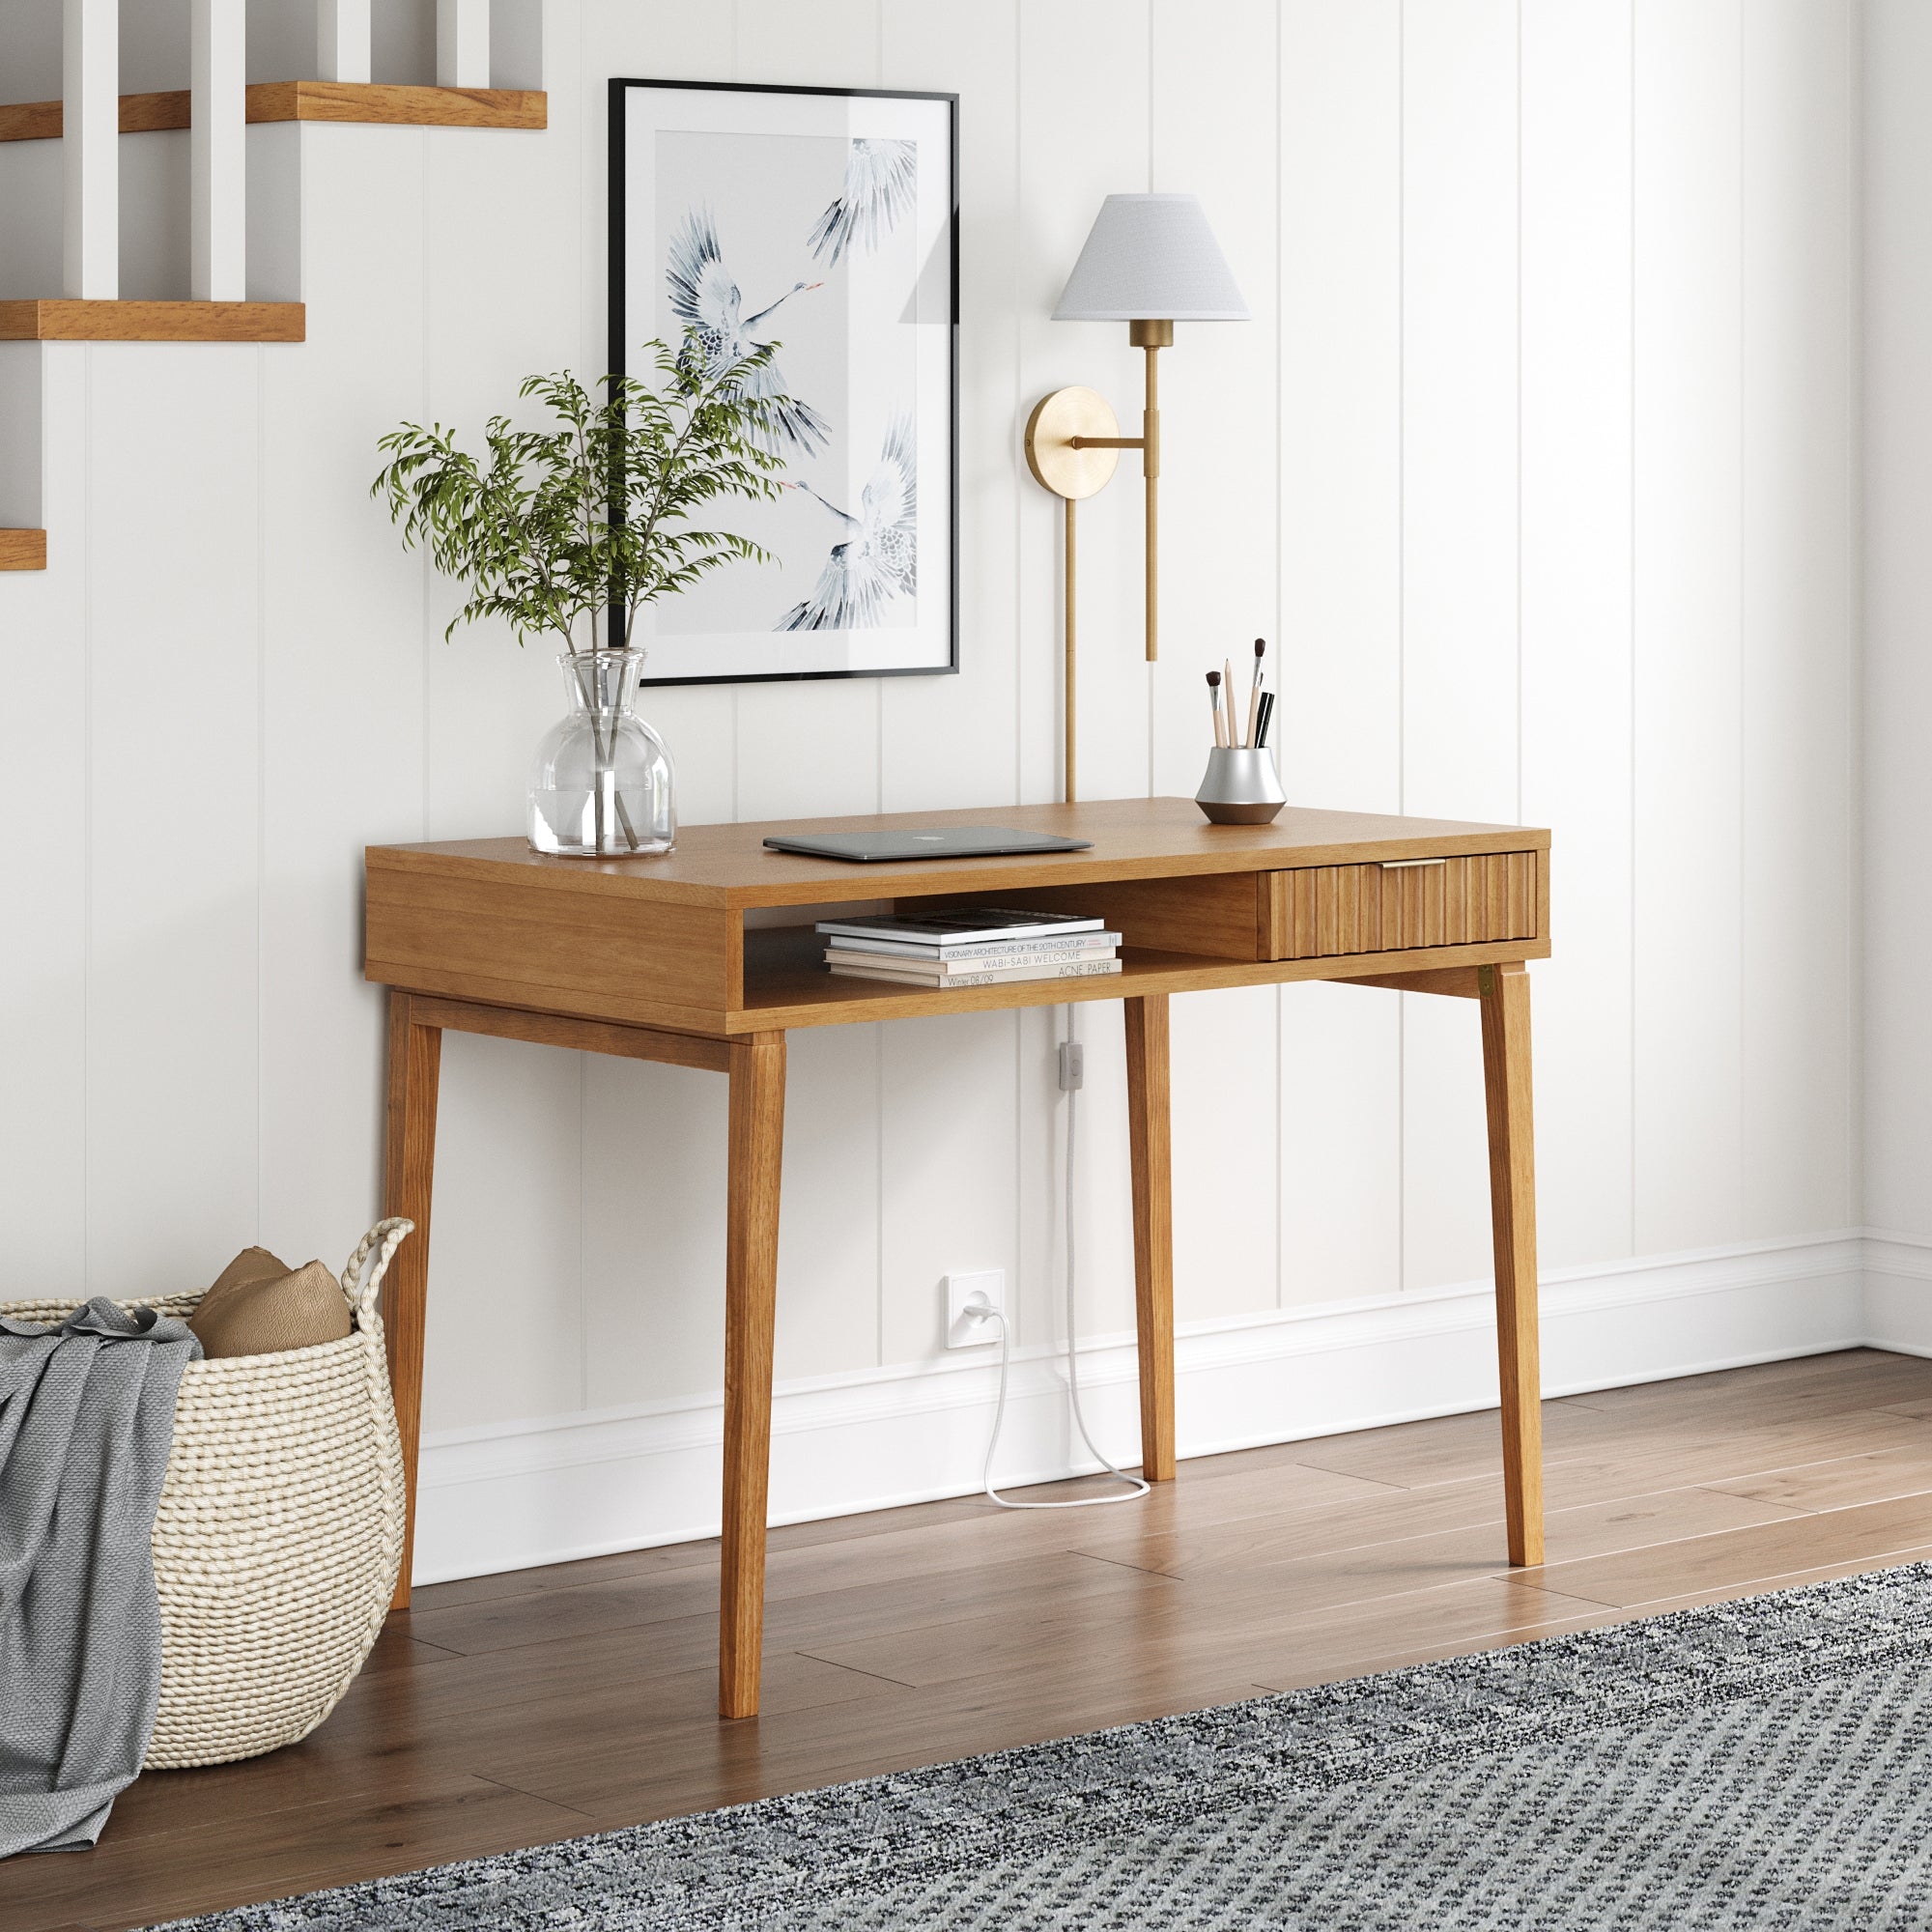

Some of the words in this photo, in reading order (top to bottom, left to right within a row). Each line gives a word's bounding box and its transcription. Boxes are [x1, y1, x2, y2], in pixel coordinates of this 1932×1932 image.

[973, 946, 1016, 956] ARCHITECTURE
[1057, 940, 1087, 949] CENTURY
[982, 956, 1031, 968] WABI-SABI
[1035, 952, 1081, 963] WELCOME
[1059, 965, 1083, 977] ACNE
[1088, 962, 1111, 974] PAPER
